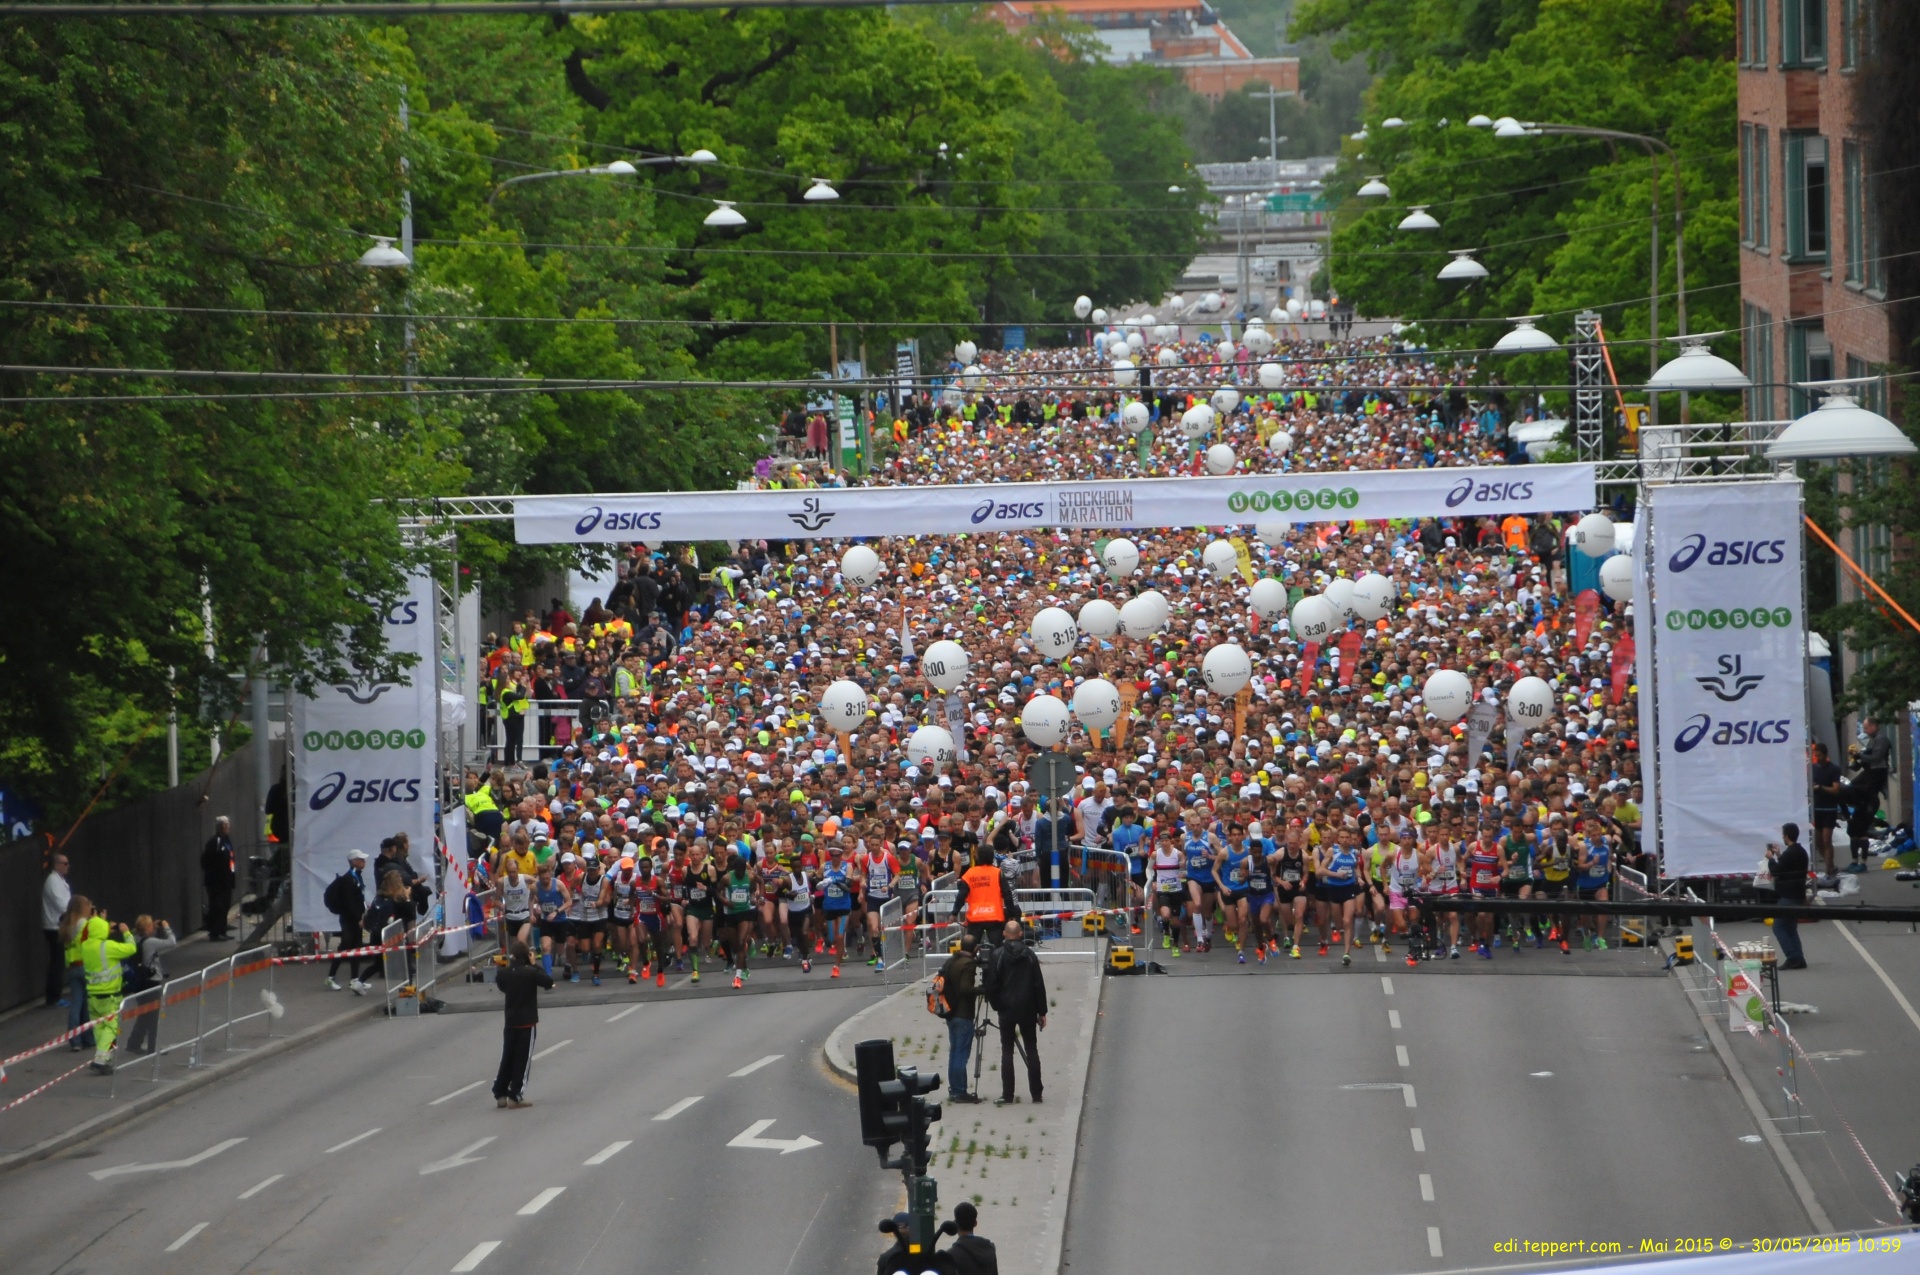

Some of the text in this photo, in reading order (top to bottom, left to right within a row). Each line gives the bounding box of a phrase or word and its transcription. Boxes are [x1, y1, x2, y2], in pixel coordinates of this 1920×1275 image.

[1058, 489, 1133, 507] STOCKHOLM
[1229, 488, 1358, 512] UNIBET
[1474, 481, 1533, 501] asics
[803, 497, 820, 513] SJ
[994, 501, 1043, 520] asics
[1058, 506, 1133, 523] MARATHON
[603, 511, 661, 530] asics
[1707, 540, 1785, 566] asics
[1304, 621, 1326, 636] 3:30
[1667, 608, 1791, 630] UNIBET
[1053, 626, 1075, 646] 3:15
[923, 660, 946, 677] 3:00
[1221, 669, 1248, 679] GARMIN
[1718, 654, 1742, 676] SJ
[845, 701, 866, 717] 3:15
[1518, 701, 1543, 717] 3:00
[304, 730, 424, 750] UNIBET
[1712, 719, 1790, 744] asics
[346, 779, 420, 803] asics
